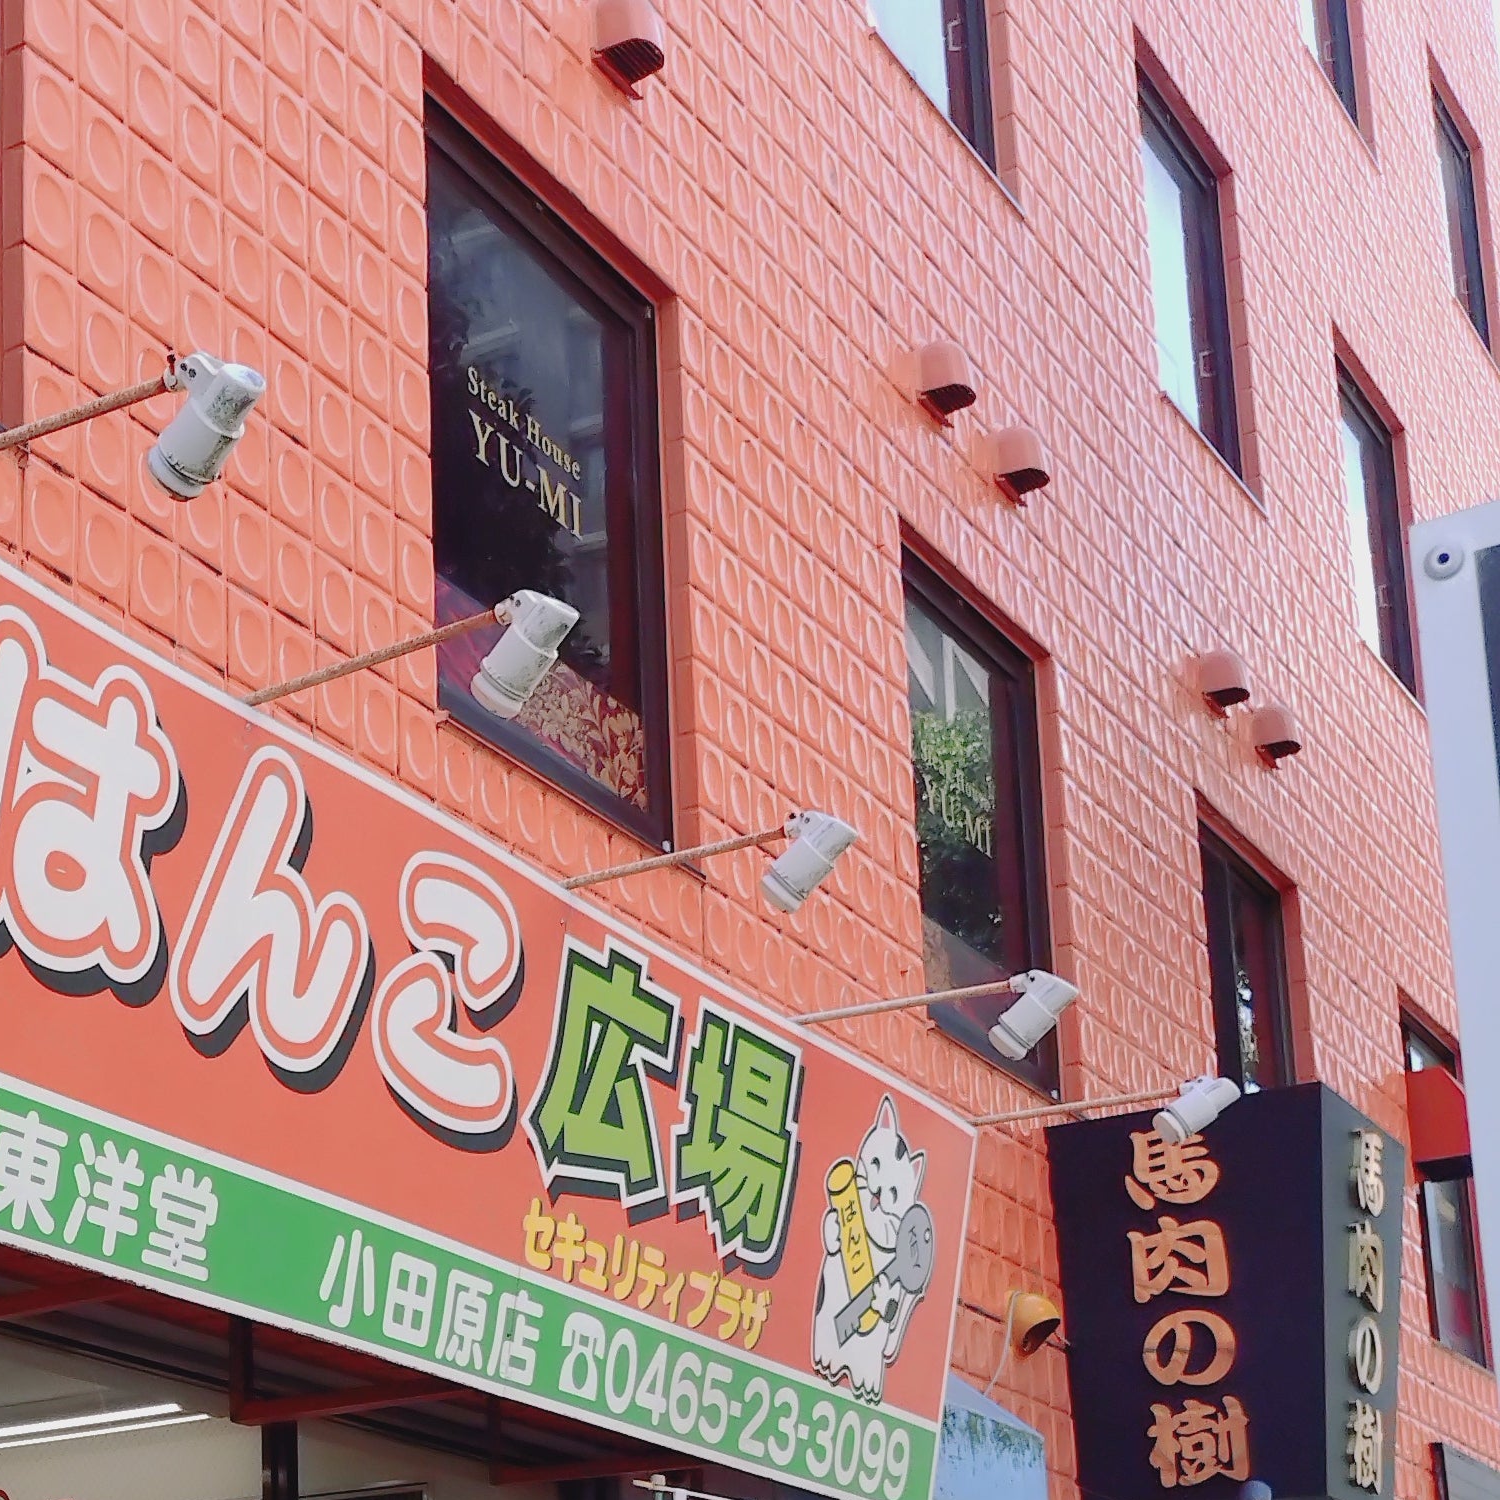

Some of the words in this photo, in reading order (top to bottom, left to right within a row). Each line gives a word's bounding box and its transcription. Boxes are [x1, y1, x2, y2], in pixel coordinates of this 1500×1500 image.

[467, 365, 520, 432] Steak
[525, 413, 581, 481] House
[468, 408, 583, 541] YU-MI
[319, 1229, 543, 1387] 小田原店
[604, 1324, 910, 1500] 0465-23-3099
[522, 1199, 771, 1351] セキュリティプラザ
[1124, 1127, 1251, 1490] 馬肉の樹
[1348, 1127, 1385, 1496] 馬肉の樹
